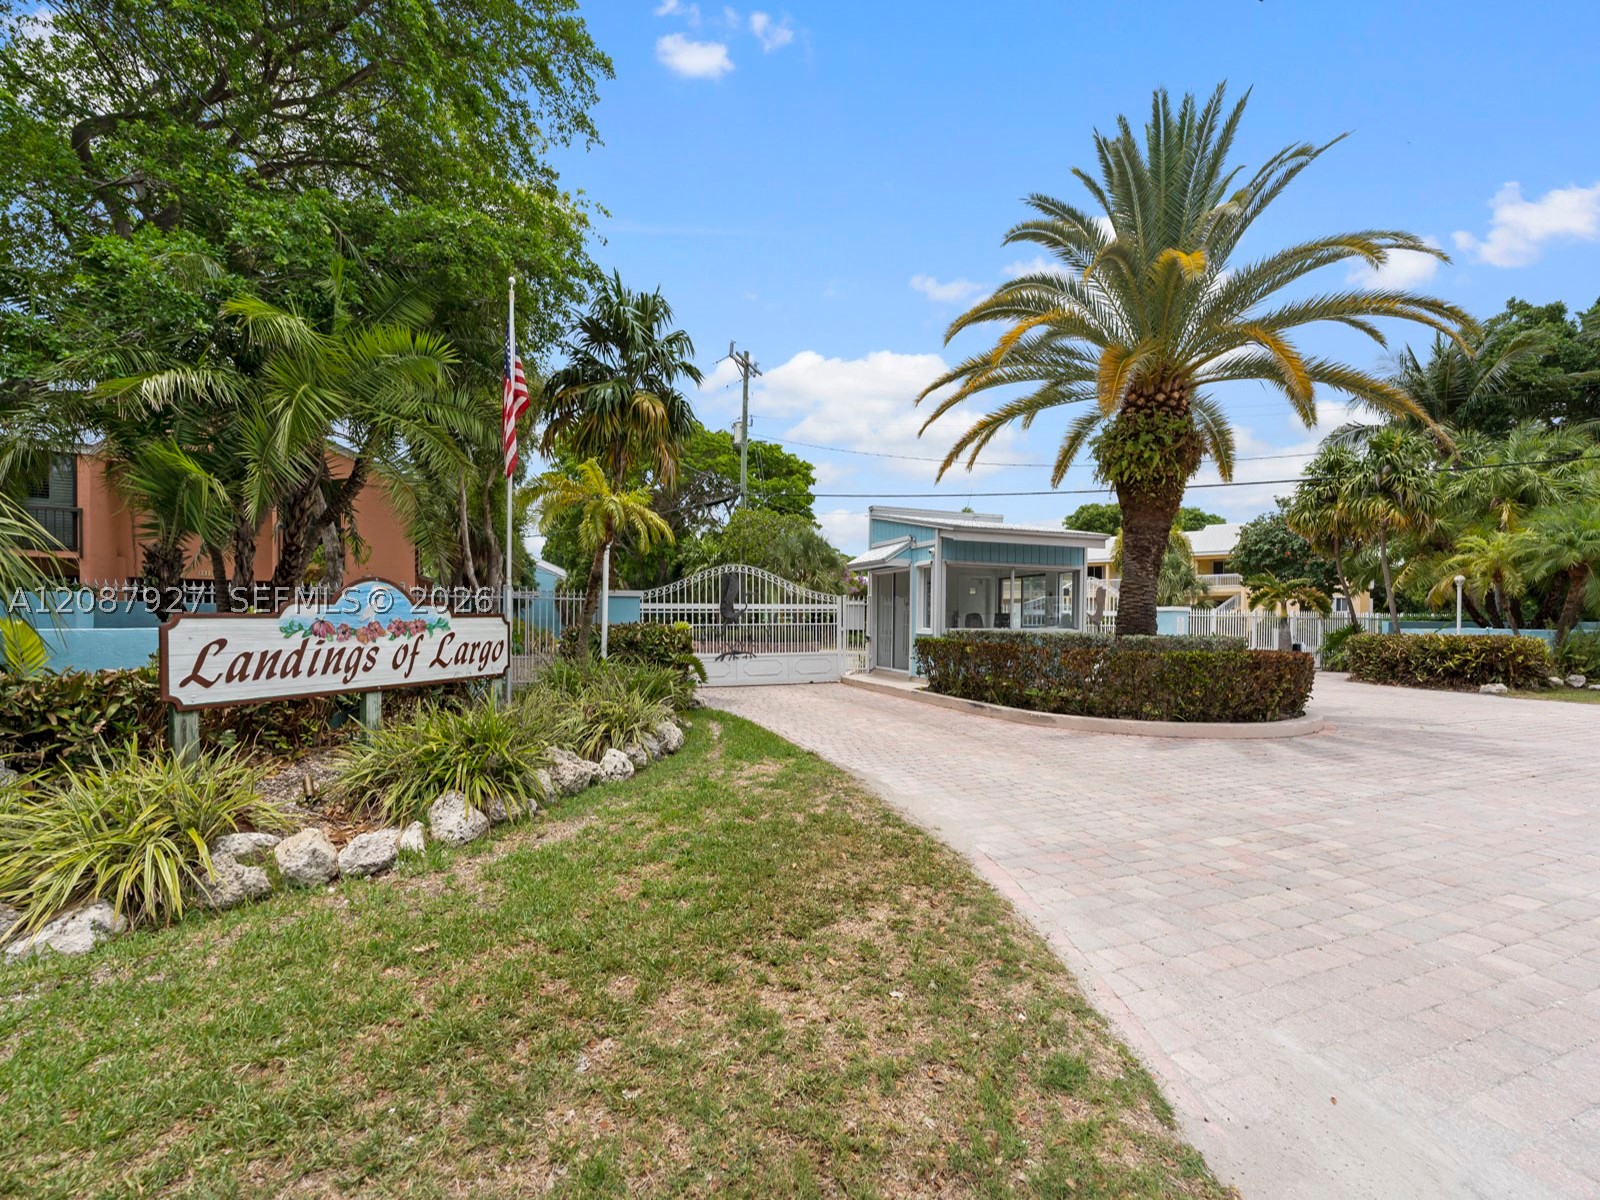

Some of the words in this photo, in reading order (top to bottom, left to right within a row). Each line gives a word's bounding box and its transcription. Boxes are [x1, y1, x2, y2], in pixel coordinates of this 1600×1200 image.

[179, 638, 380, 688] Landings
[392, 634, 424, 678] of
[429, 632, 504, 672] Largo
